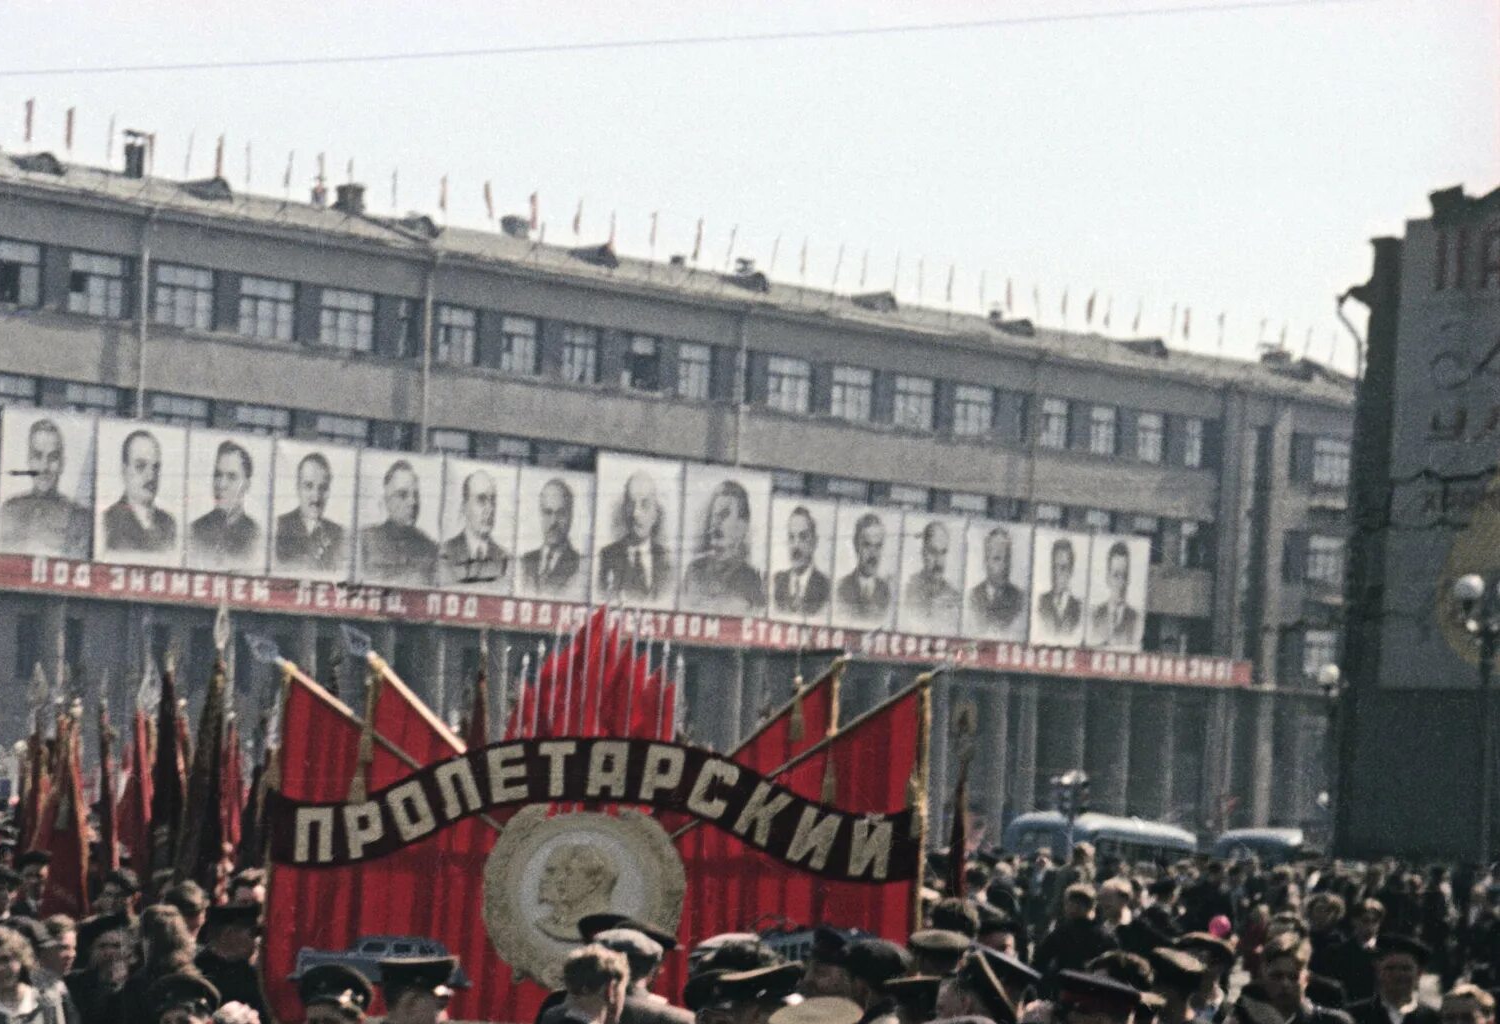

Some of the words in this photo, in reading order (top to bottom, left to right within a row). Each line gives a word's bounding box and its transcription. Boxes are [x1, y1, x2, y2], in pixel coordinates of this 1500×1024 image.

[31, 556, 91, 588] ПОД
[110, 567, 270, 602] ЗНАМЕНЕМ
[427, 594, 478, 618] ПОД
[294, 741, 893, 880] ПРОЛЕТАРСКИЙ
